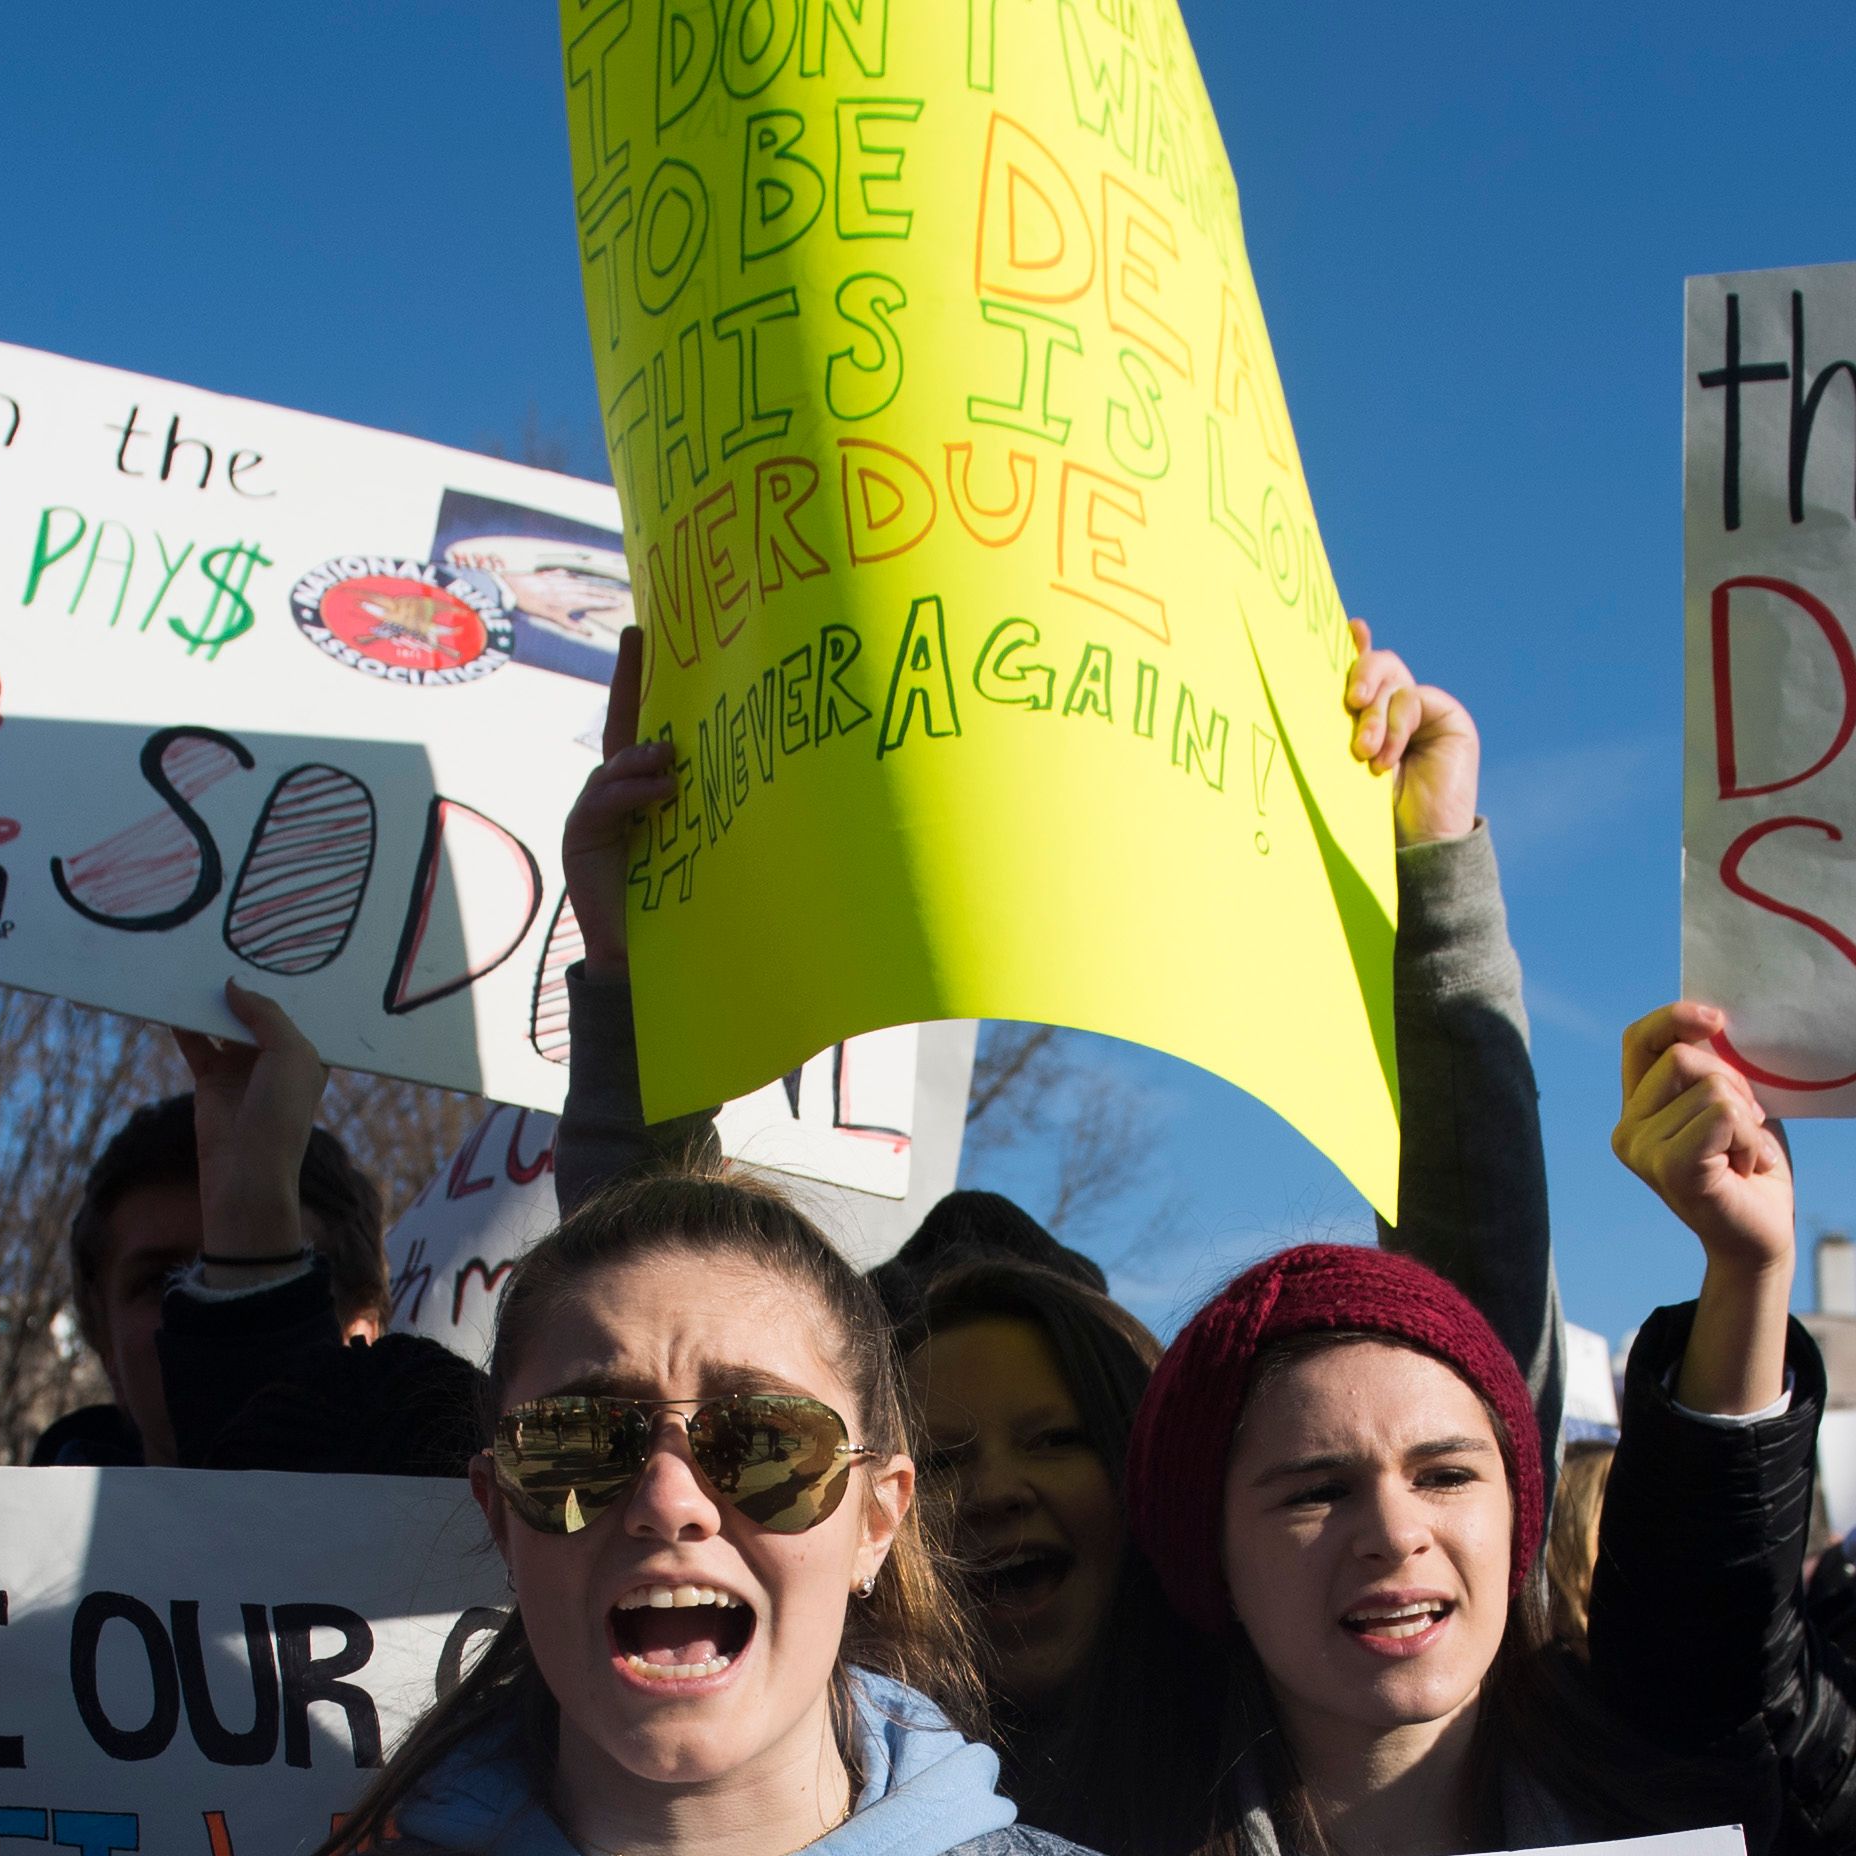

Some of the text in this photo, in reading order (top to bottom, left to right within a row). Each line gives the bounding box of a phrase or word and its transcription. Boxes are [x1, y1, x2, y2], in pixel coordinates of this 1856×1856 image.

[582, 97, 1291, 472] TO BE DEA
[108, 406, 276, 498] the
[606, 272, 1356, 672] THIS IS LON
[294, 556, 512, 634] NATIONAL RIFLE
[303, 625, 510, 686] ASSOCIATION
[70, 1591, 384, 1768] OUR
